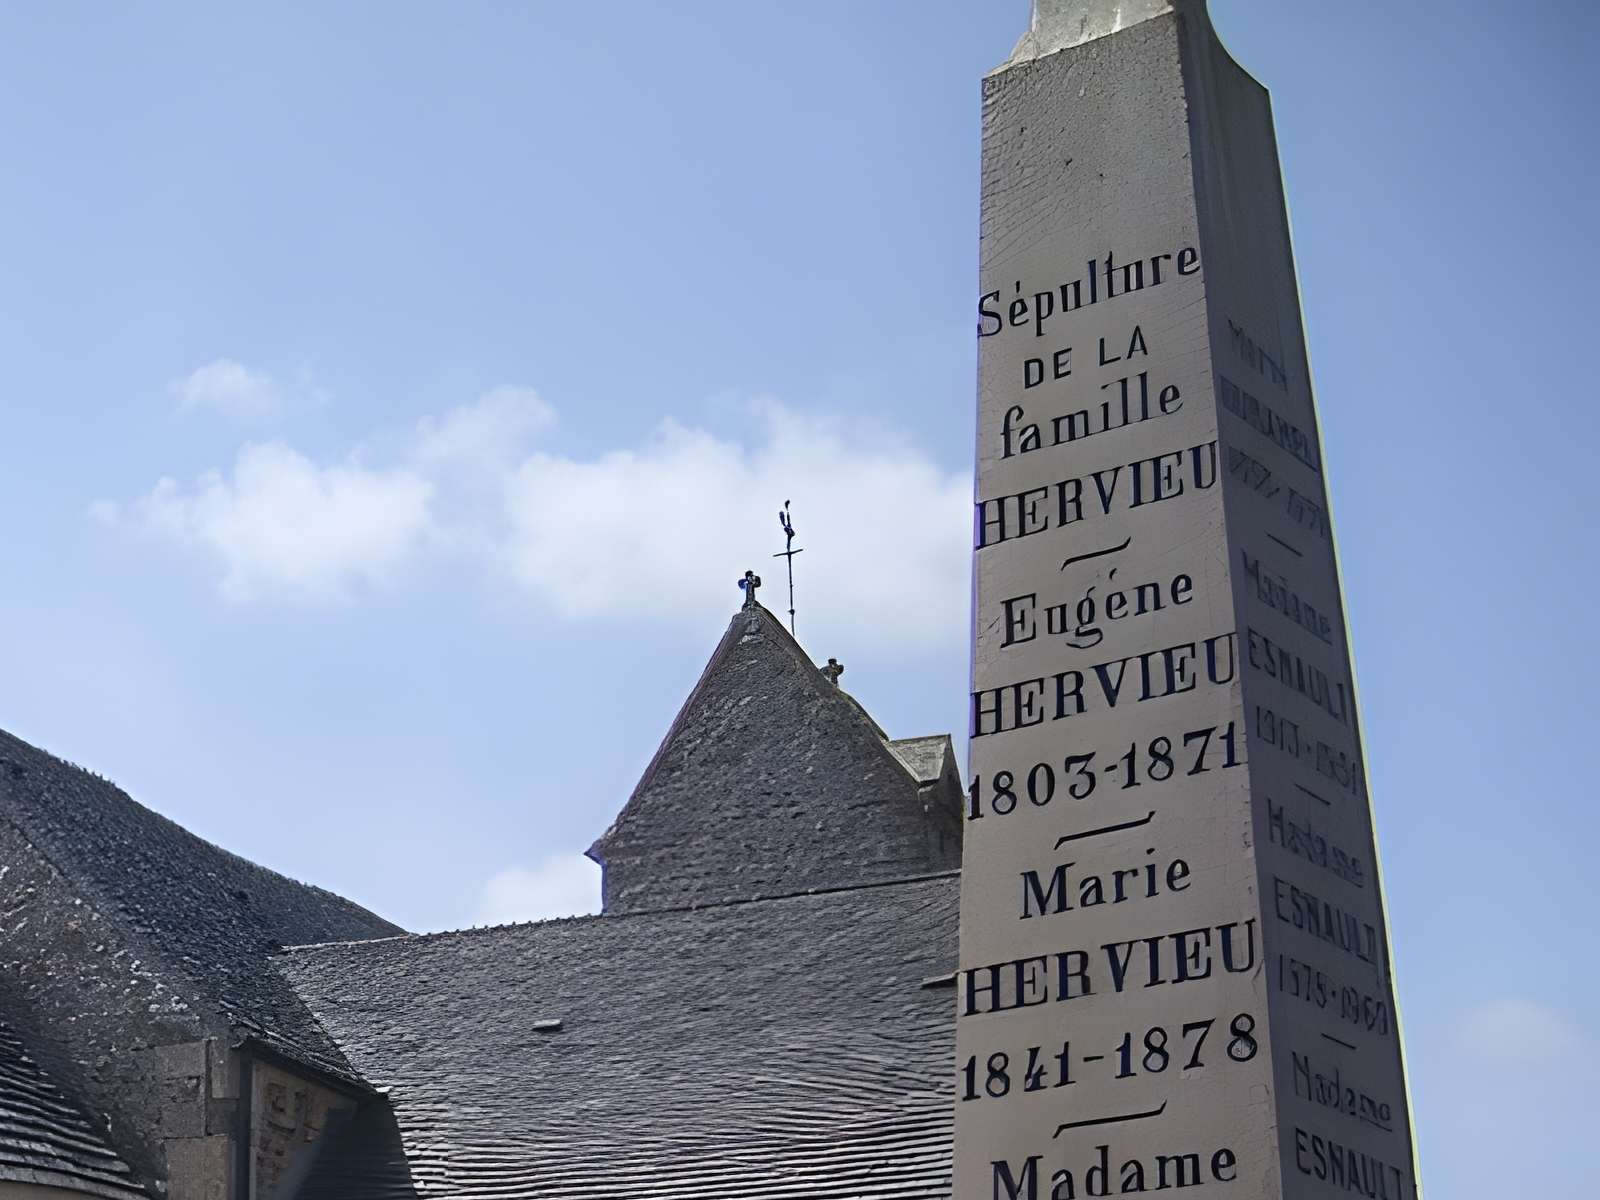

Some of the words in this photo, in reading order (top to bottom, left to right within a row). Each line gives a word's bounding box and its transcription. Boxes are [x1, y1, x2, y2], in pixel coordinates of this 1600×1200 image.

[977, 245, 1202, 338] Sépulture
[1024, 347, 1073, 389] DE
[1099, 325, 1149, 367] LA
[1000, 371, 1183, 460] famille
[974, 440, 1218, 551] HERVIEU
[970, 632, 1240, 738] HERVIEU
[968, 720, 1248, 820] 1803-1871
[1020, 848, 1192, 920] Marie
[961, 917, 1257, 1016] HERVIEU
[962, 1013, 1258, 1101] 1841-1878
